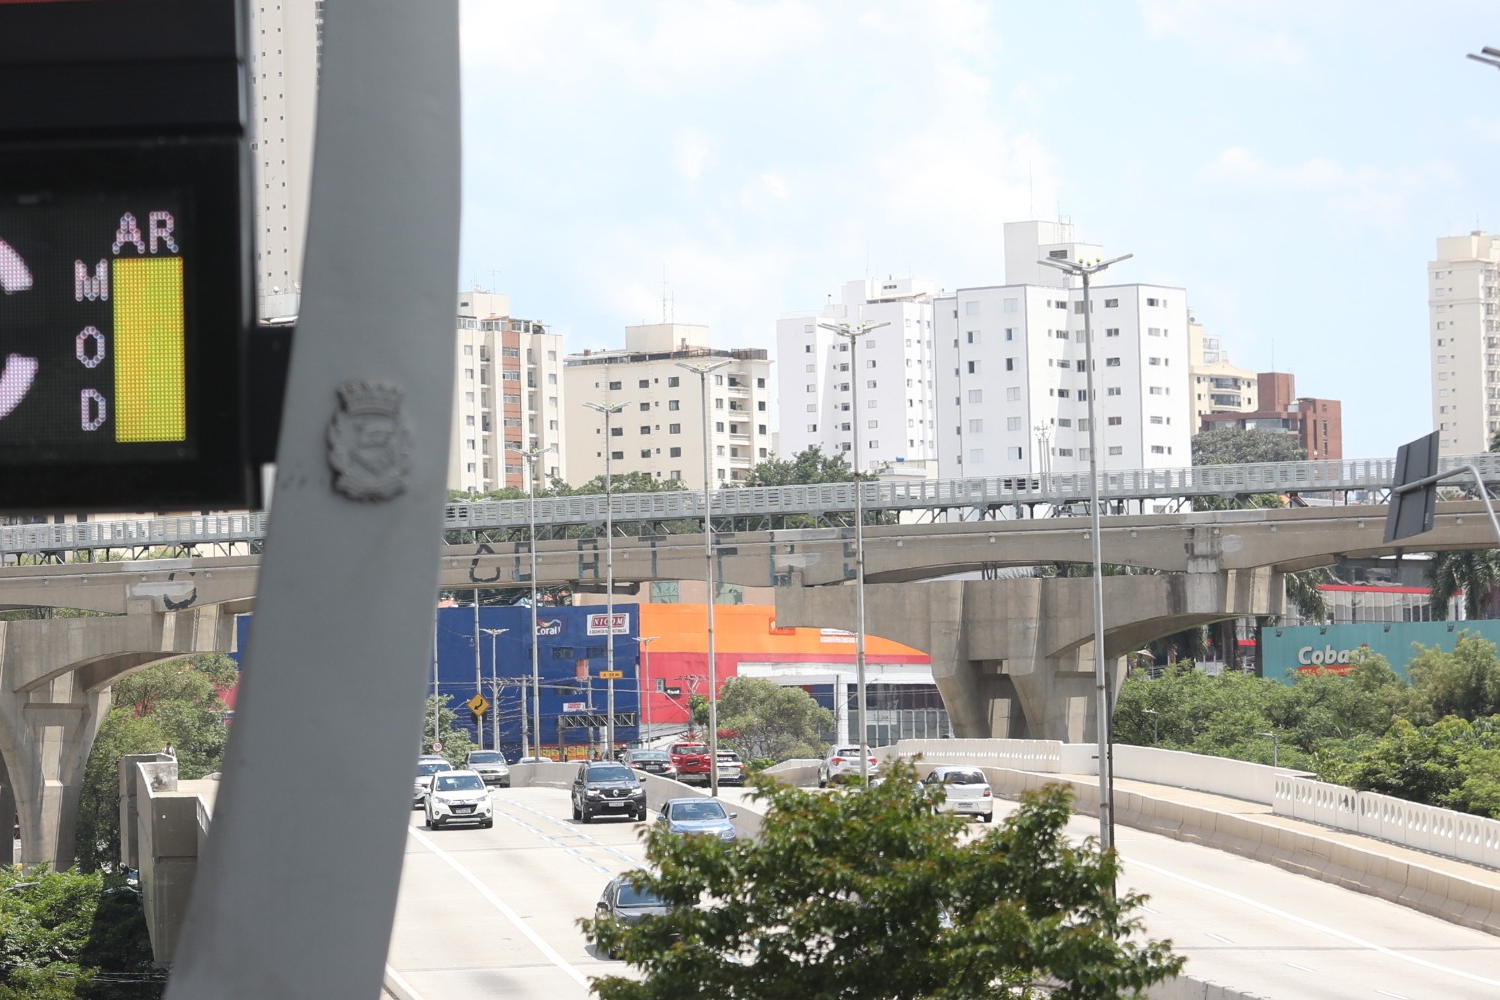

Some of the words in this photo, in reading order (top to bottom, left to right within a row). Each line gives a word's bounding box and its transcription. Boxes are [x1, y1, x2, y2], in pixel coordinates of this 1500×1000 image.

[112, 211, 179, 254] AR
[536, 625, 559, 635] Coral
[1298, 644, 1367, 665] Coba
